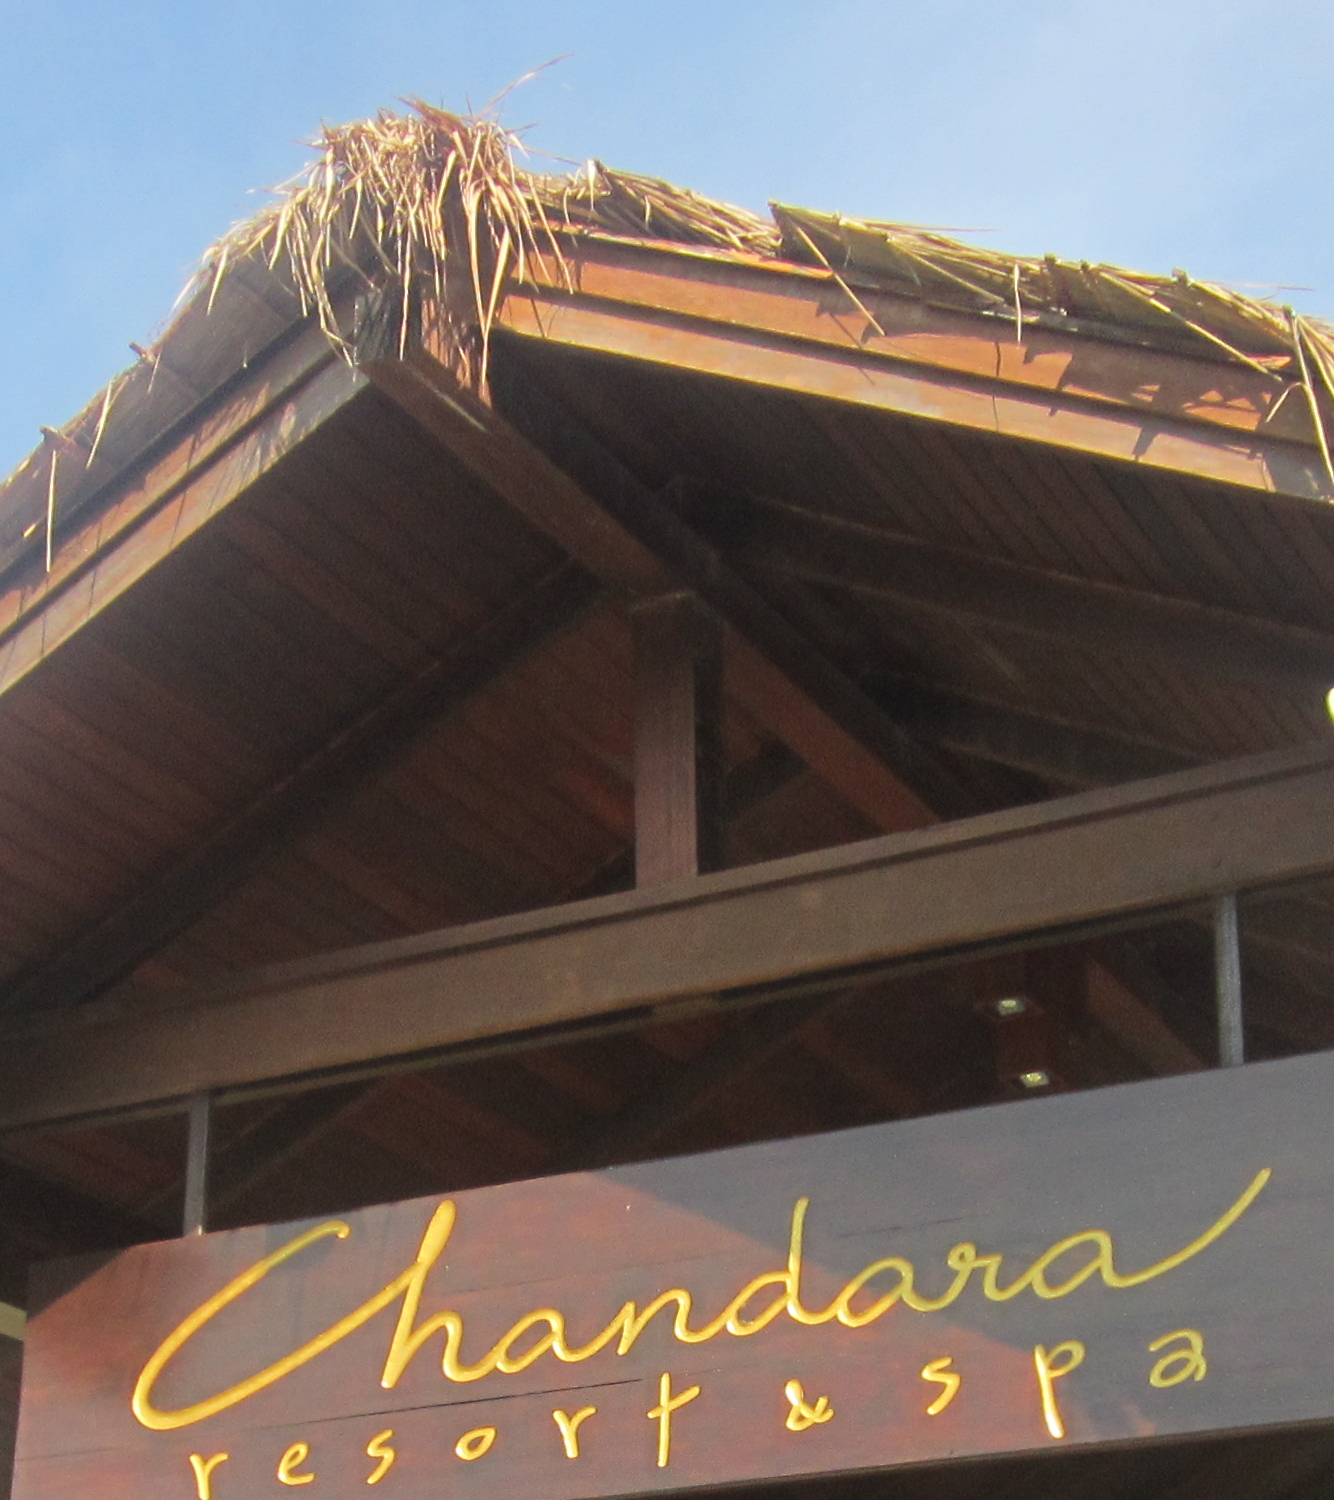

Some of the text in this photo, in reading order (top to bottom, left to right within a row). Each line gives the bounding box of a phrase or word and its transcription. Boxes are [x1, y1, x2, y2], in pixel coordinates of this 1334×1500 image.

[130, 1168, 1271, 1431] Chandara
[779, 1378, 837, 1435] &
[918, 1328, 1209, 1440] spa
